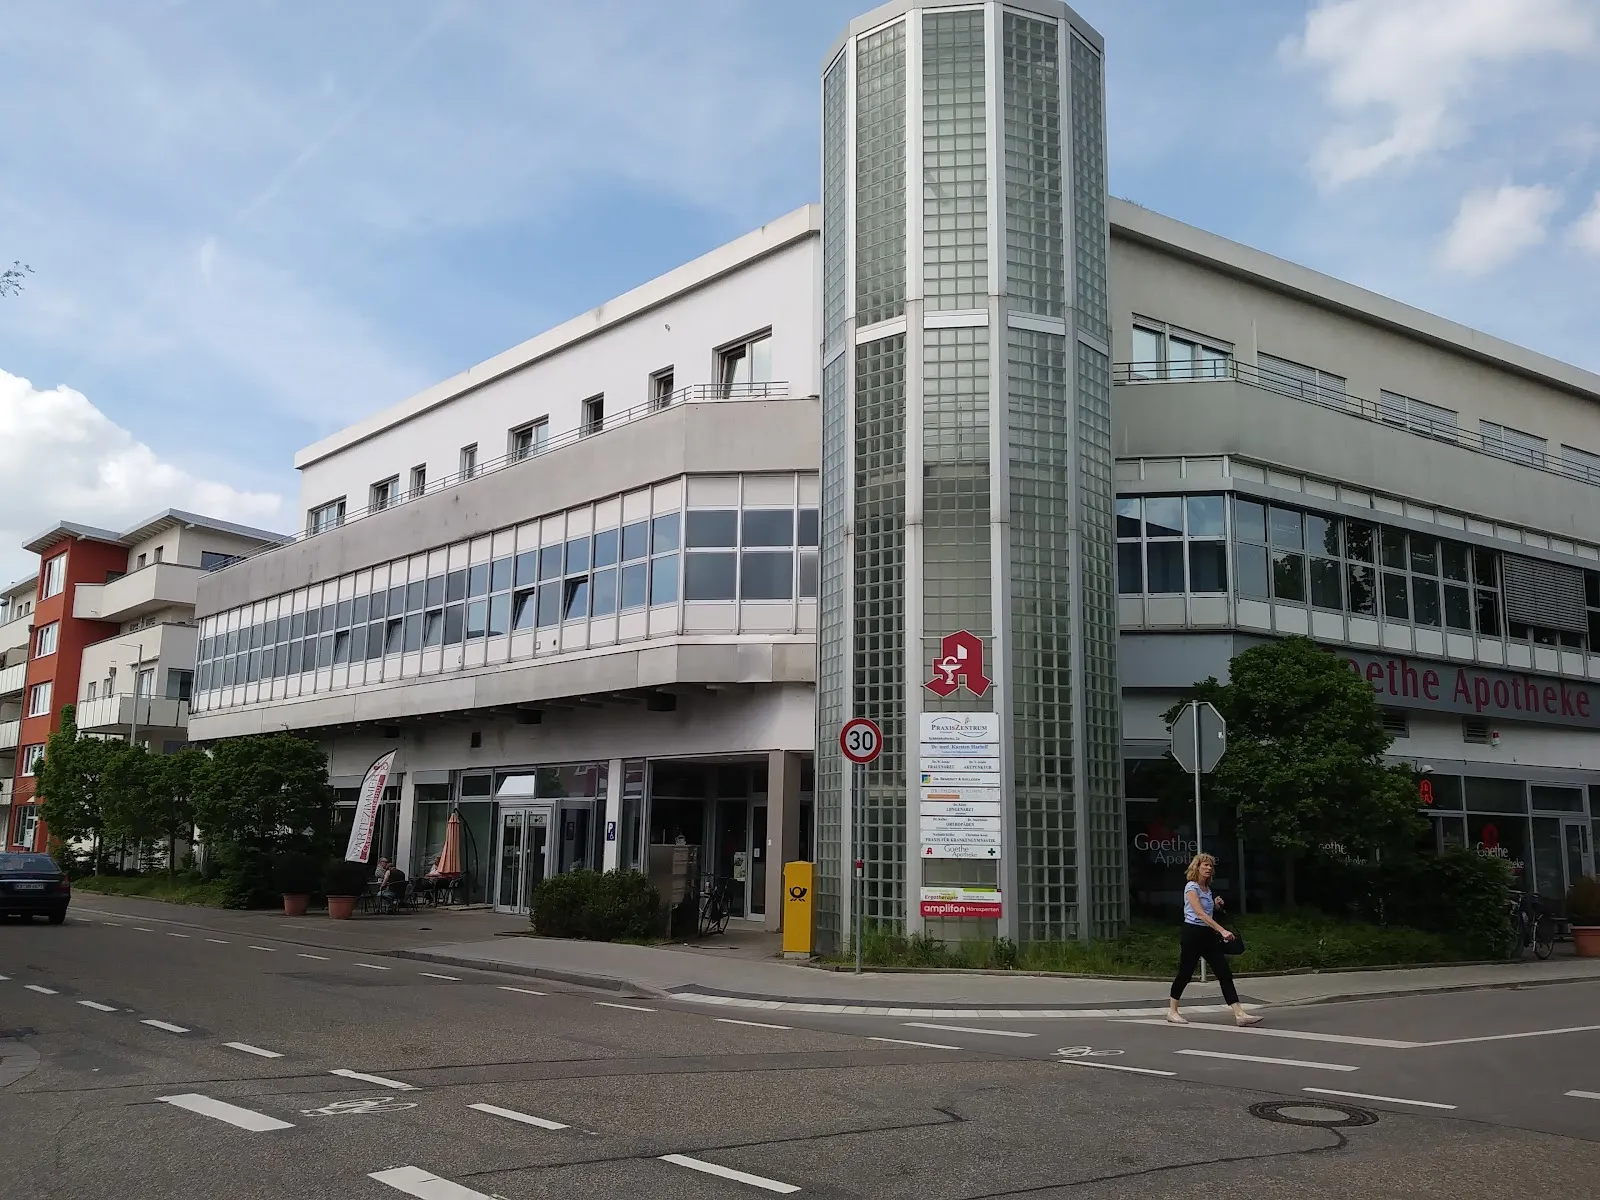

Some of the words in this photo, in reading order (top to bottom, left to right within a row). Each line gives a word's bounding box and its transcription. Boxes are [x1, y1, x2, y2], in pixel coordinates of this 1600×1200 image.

[1453, 668, 1590, 718] Apotheke
[848, 730, 874, 751] 30
[1134, 832, 1198, 852] Goethe
[924, 904, 966, 914] amplifon
